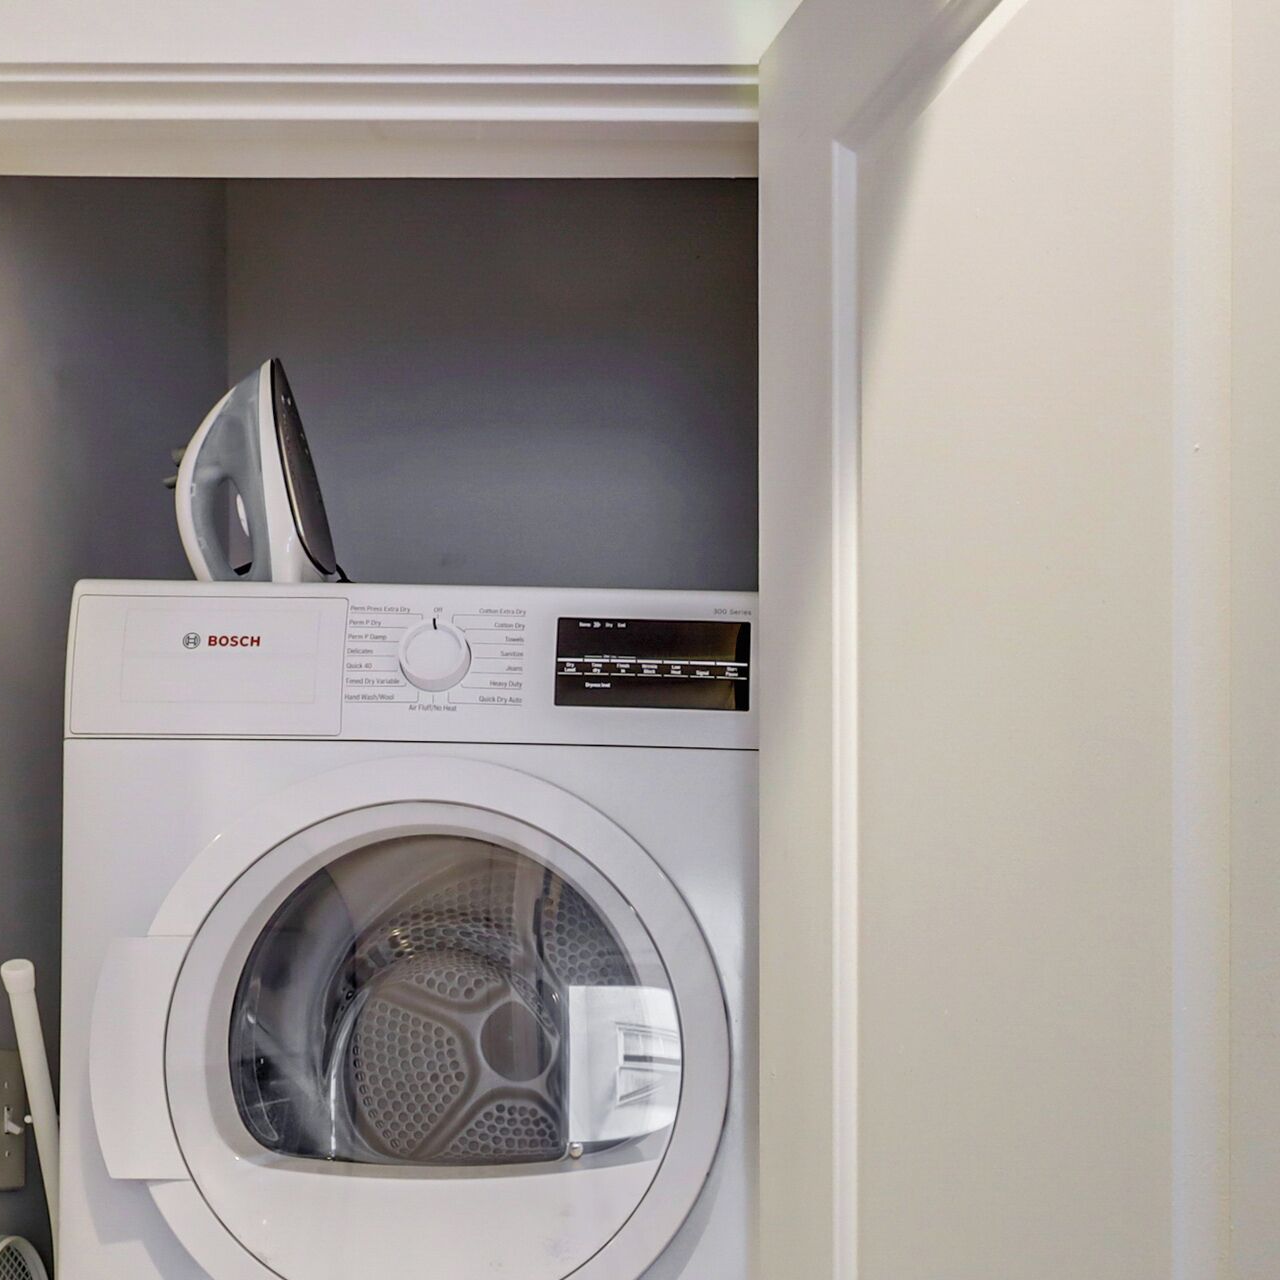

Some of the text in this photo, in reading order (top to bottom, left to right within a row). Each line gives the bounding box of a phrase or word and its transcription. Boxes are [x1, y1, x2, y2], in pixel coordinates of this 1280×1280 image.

[400, 606, 411, 614] Dry
[713, 608, 752, 616] 300 Series
[515, 623, 526, 631] Dry
[207, 635, 261, 647] BOSCH
[489, 680, 523, 688] Heavy Duty
[496, 696, 508, 704] Dry
